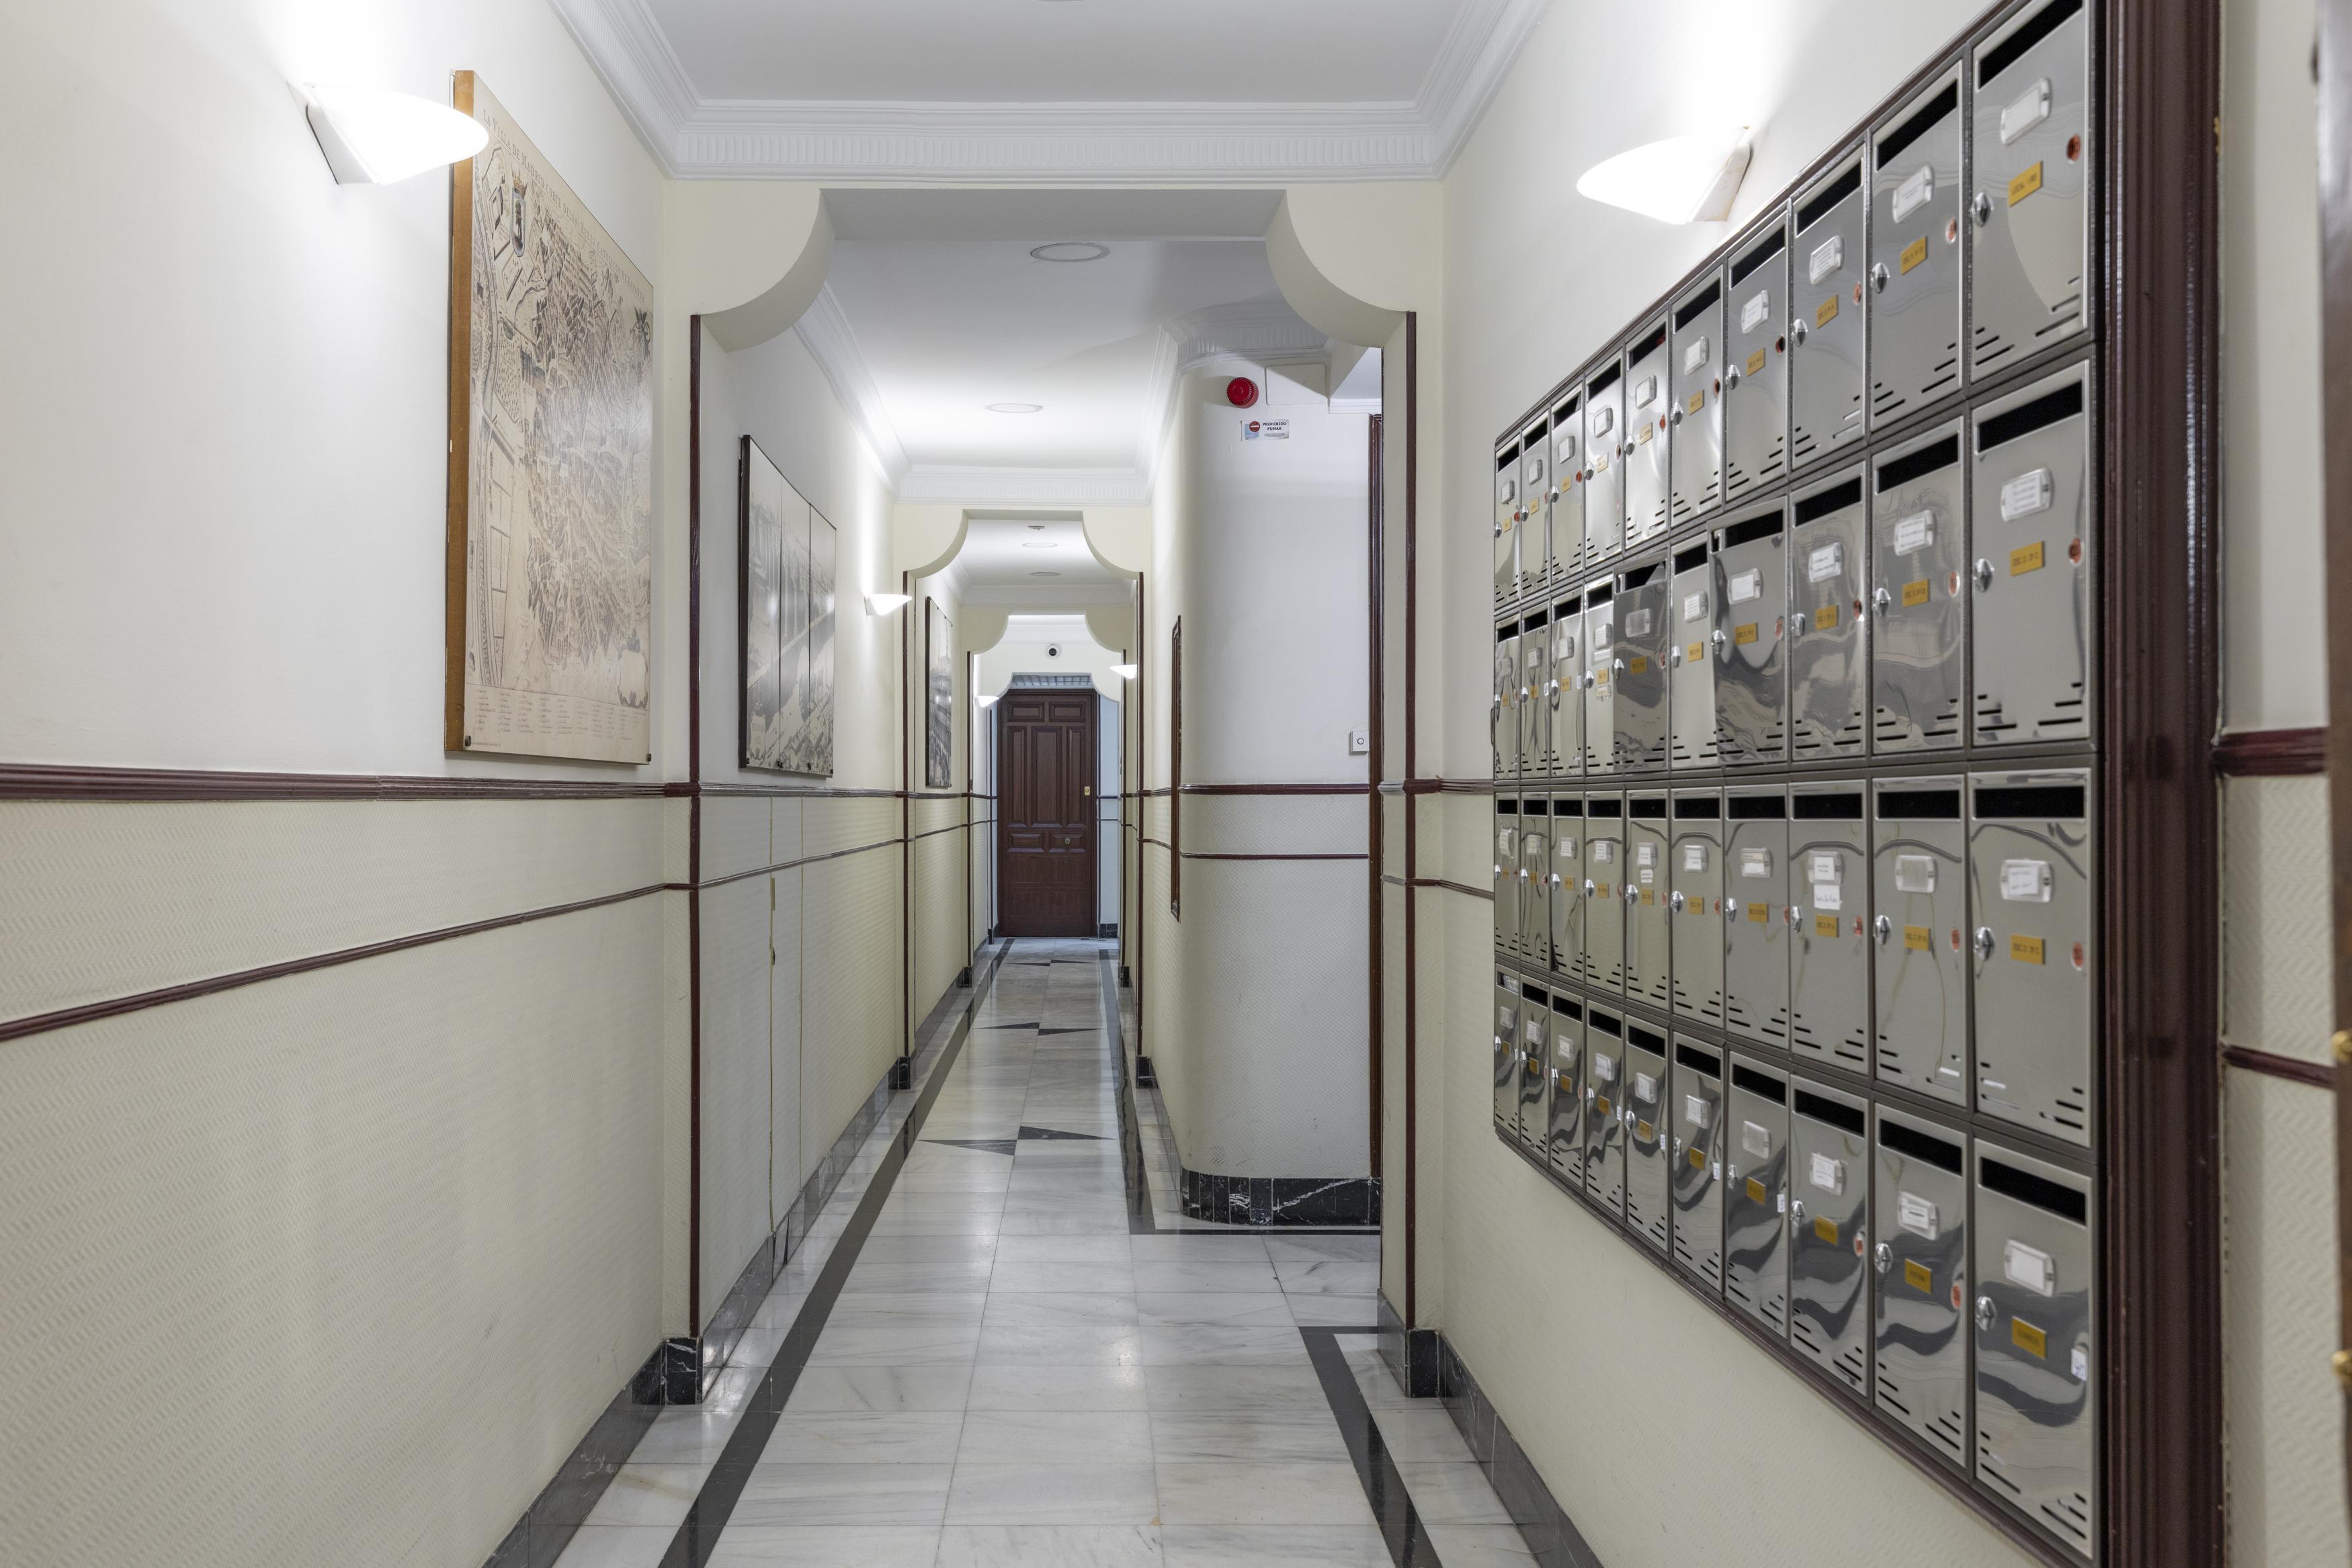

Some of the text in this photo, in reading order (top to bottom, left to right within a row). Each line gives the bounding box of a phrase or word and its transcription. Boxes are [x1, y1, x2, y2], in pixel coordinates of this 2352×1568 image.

[483, 109, 491, 127] LA
[493, 118, 511, 150] VILLA
[512, 143, 520, 161] DE
[521, 152, 544, 189] MADRID
[546, 183, 562, 209] CORTE
